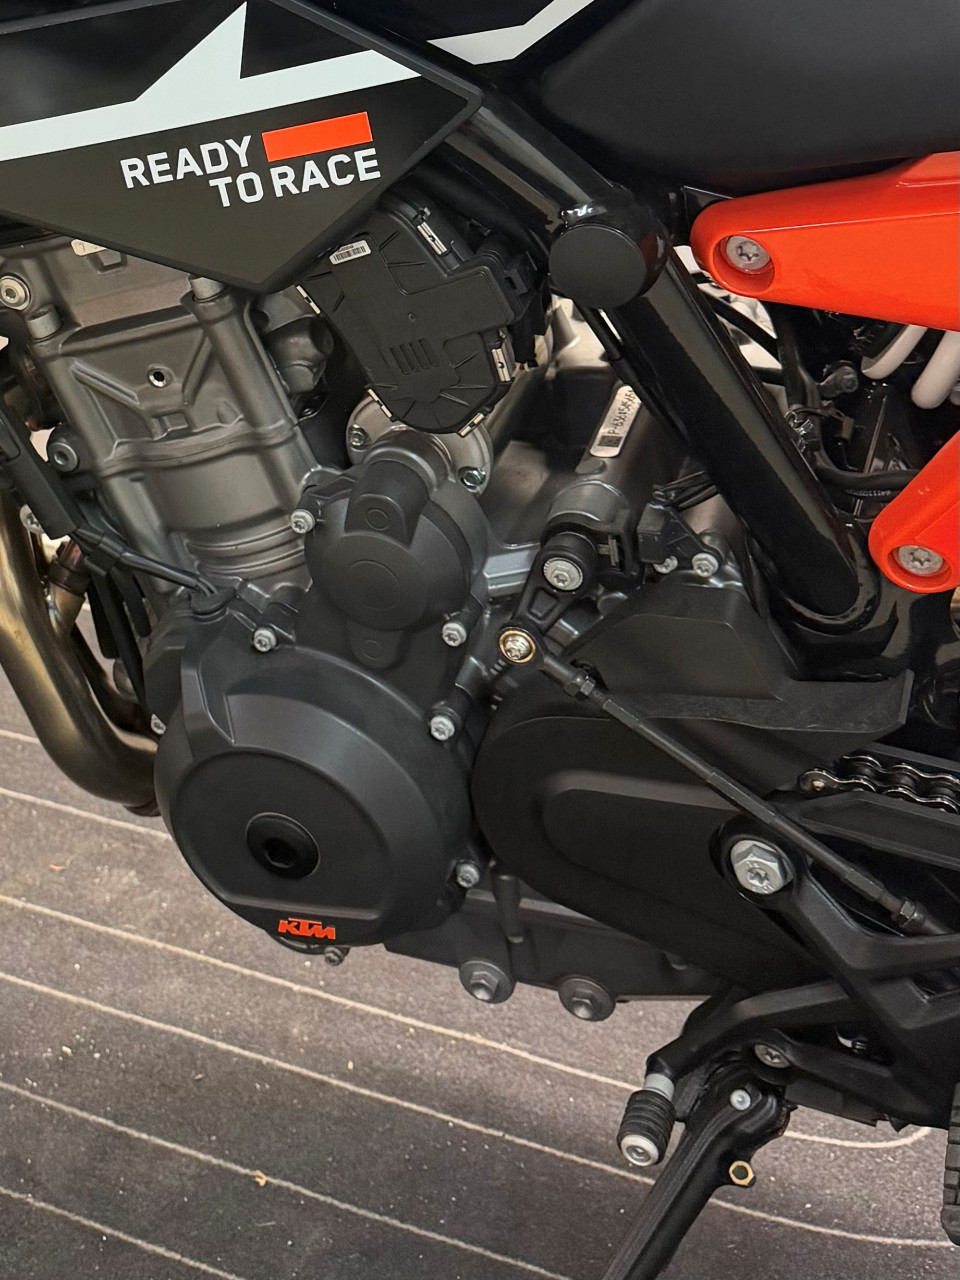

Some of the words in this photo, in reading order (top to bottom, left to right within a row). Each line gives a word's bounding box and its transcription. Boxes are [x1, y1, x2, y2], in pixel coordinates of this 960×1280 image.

[120, 135, 251, 189] READY
[209, 172, 264, 207] TO
[269, 148, 381, 198] RACE
[278, 918, 336, 940] KTM
